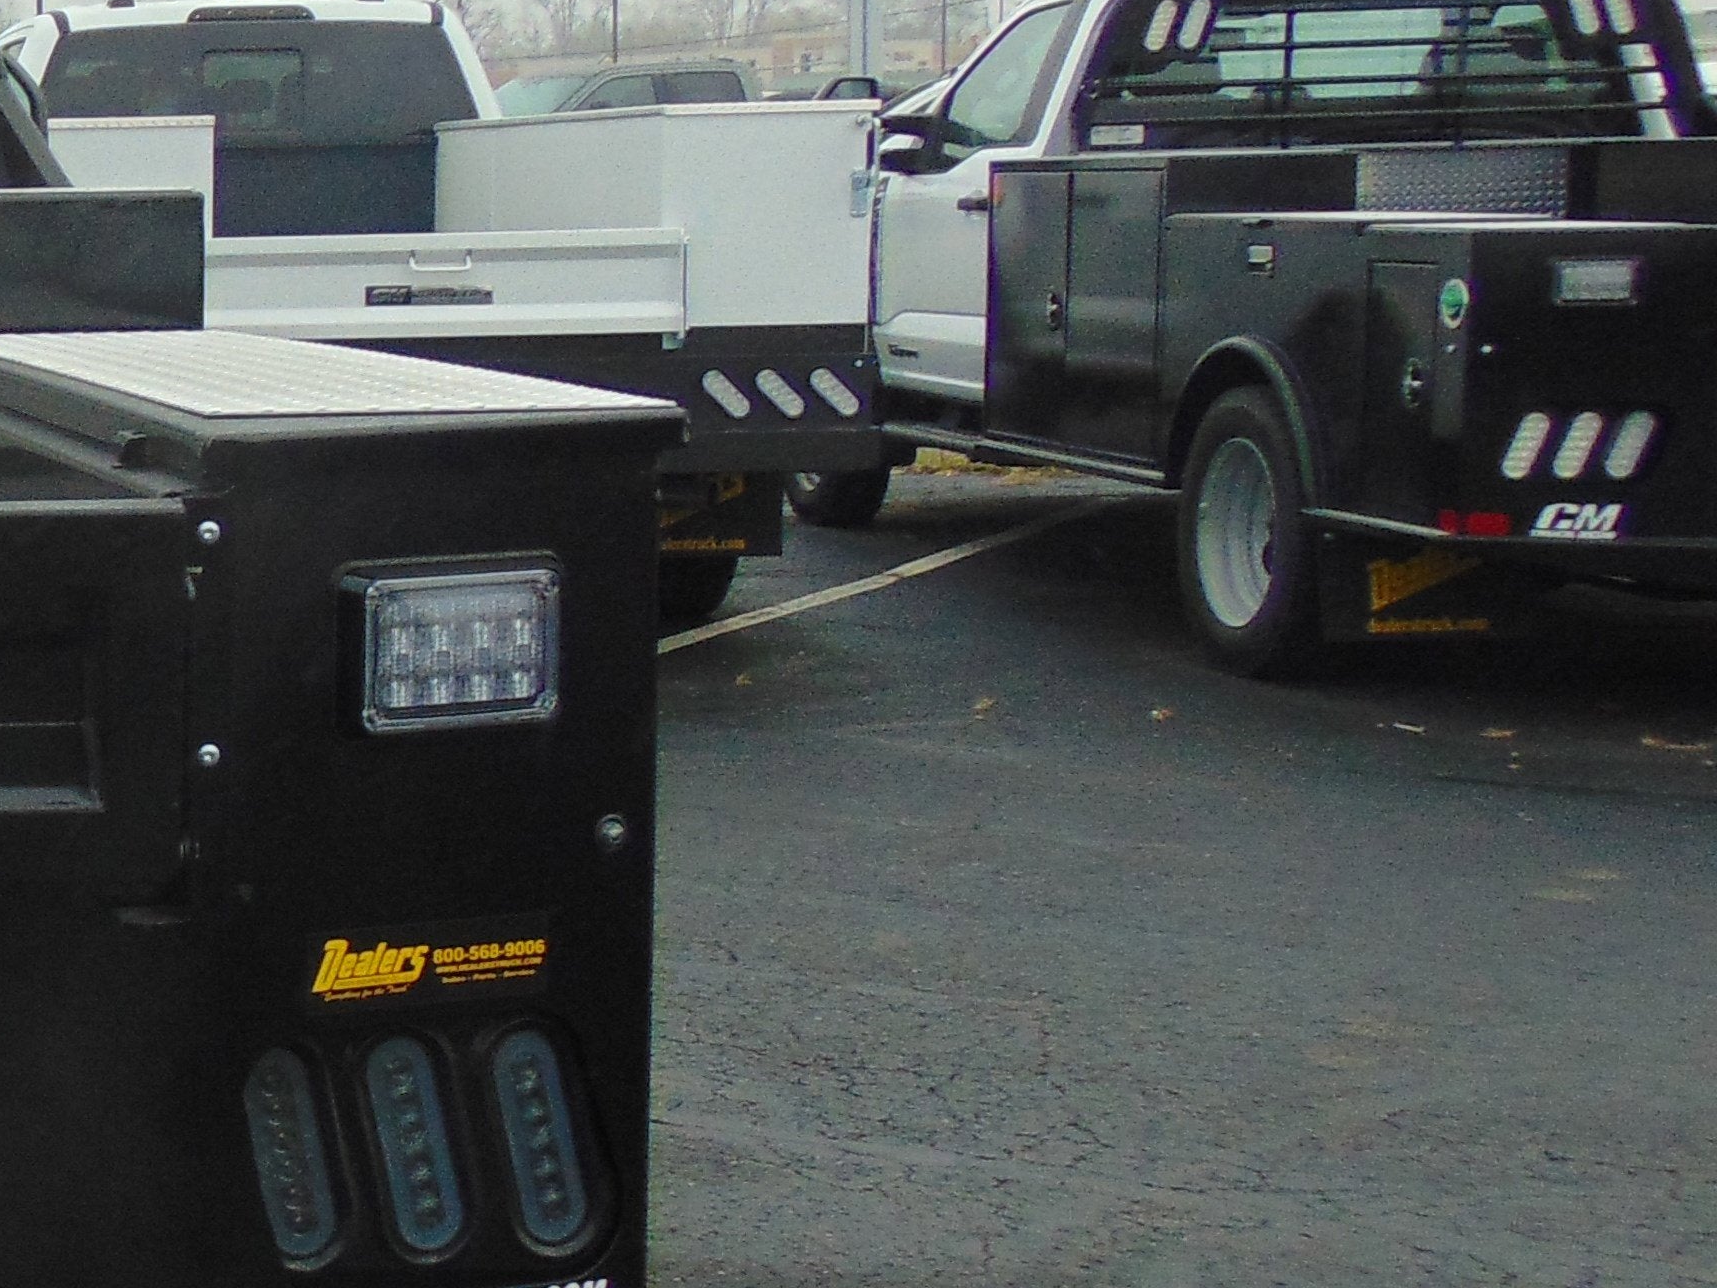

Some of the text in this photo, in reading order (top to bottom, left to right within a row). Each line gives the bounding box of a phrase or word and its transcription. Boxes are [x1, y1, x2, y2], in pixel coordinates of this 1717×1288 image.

[1535, 502, 1625, 531] CM
[311, 938, 546, 993] Dealers 800-568-9006
